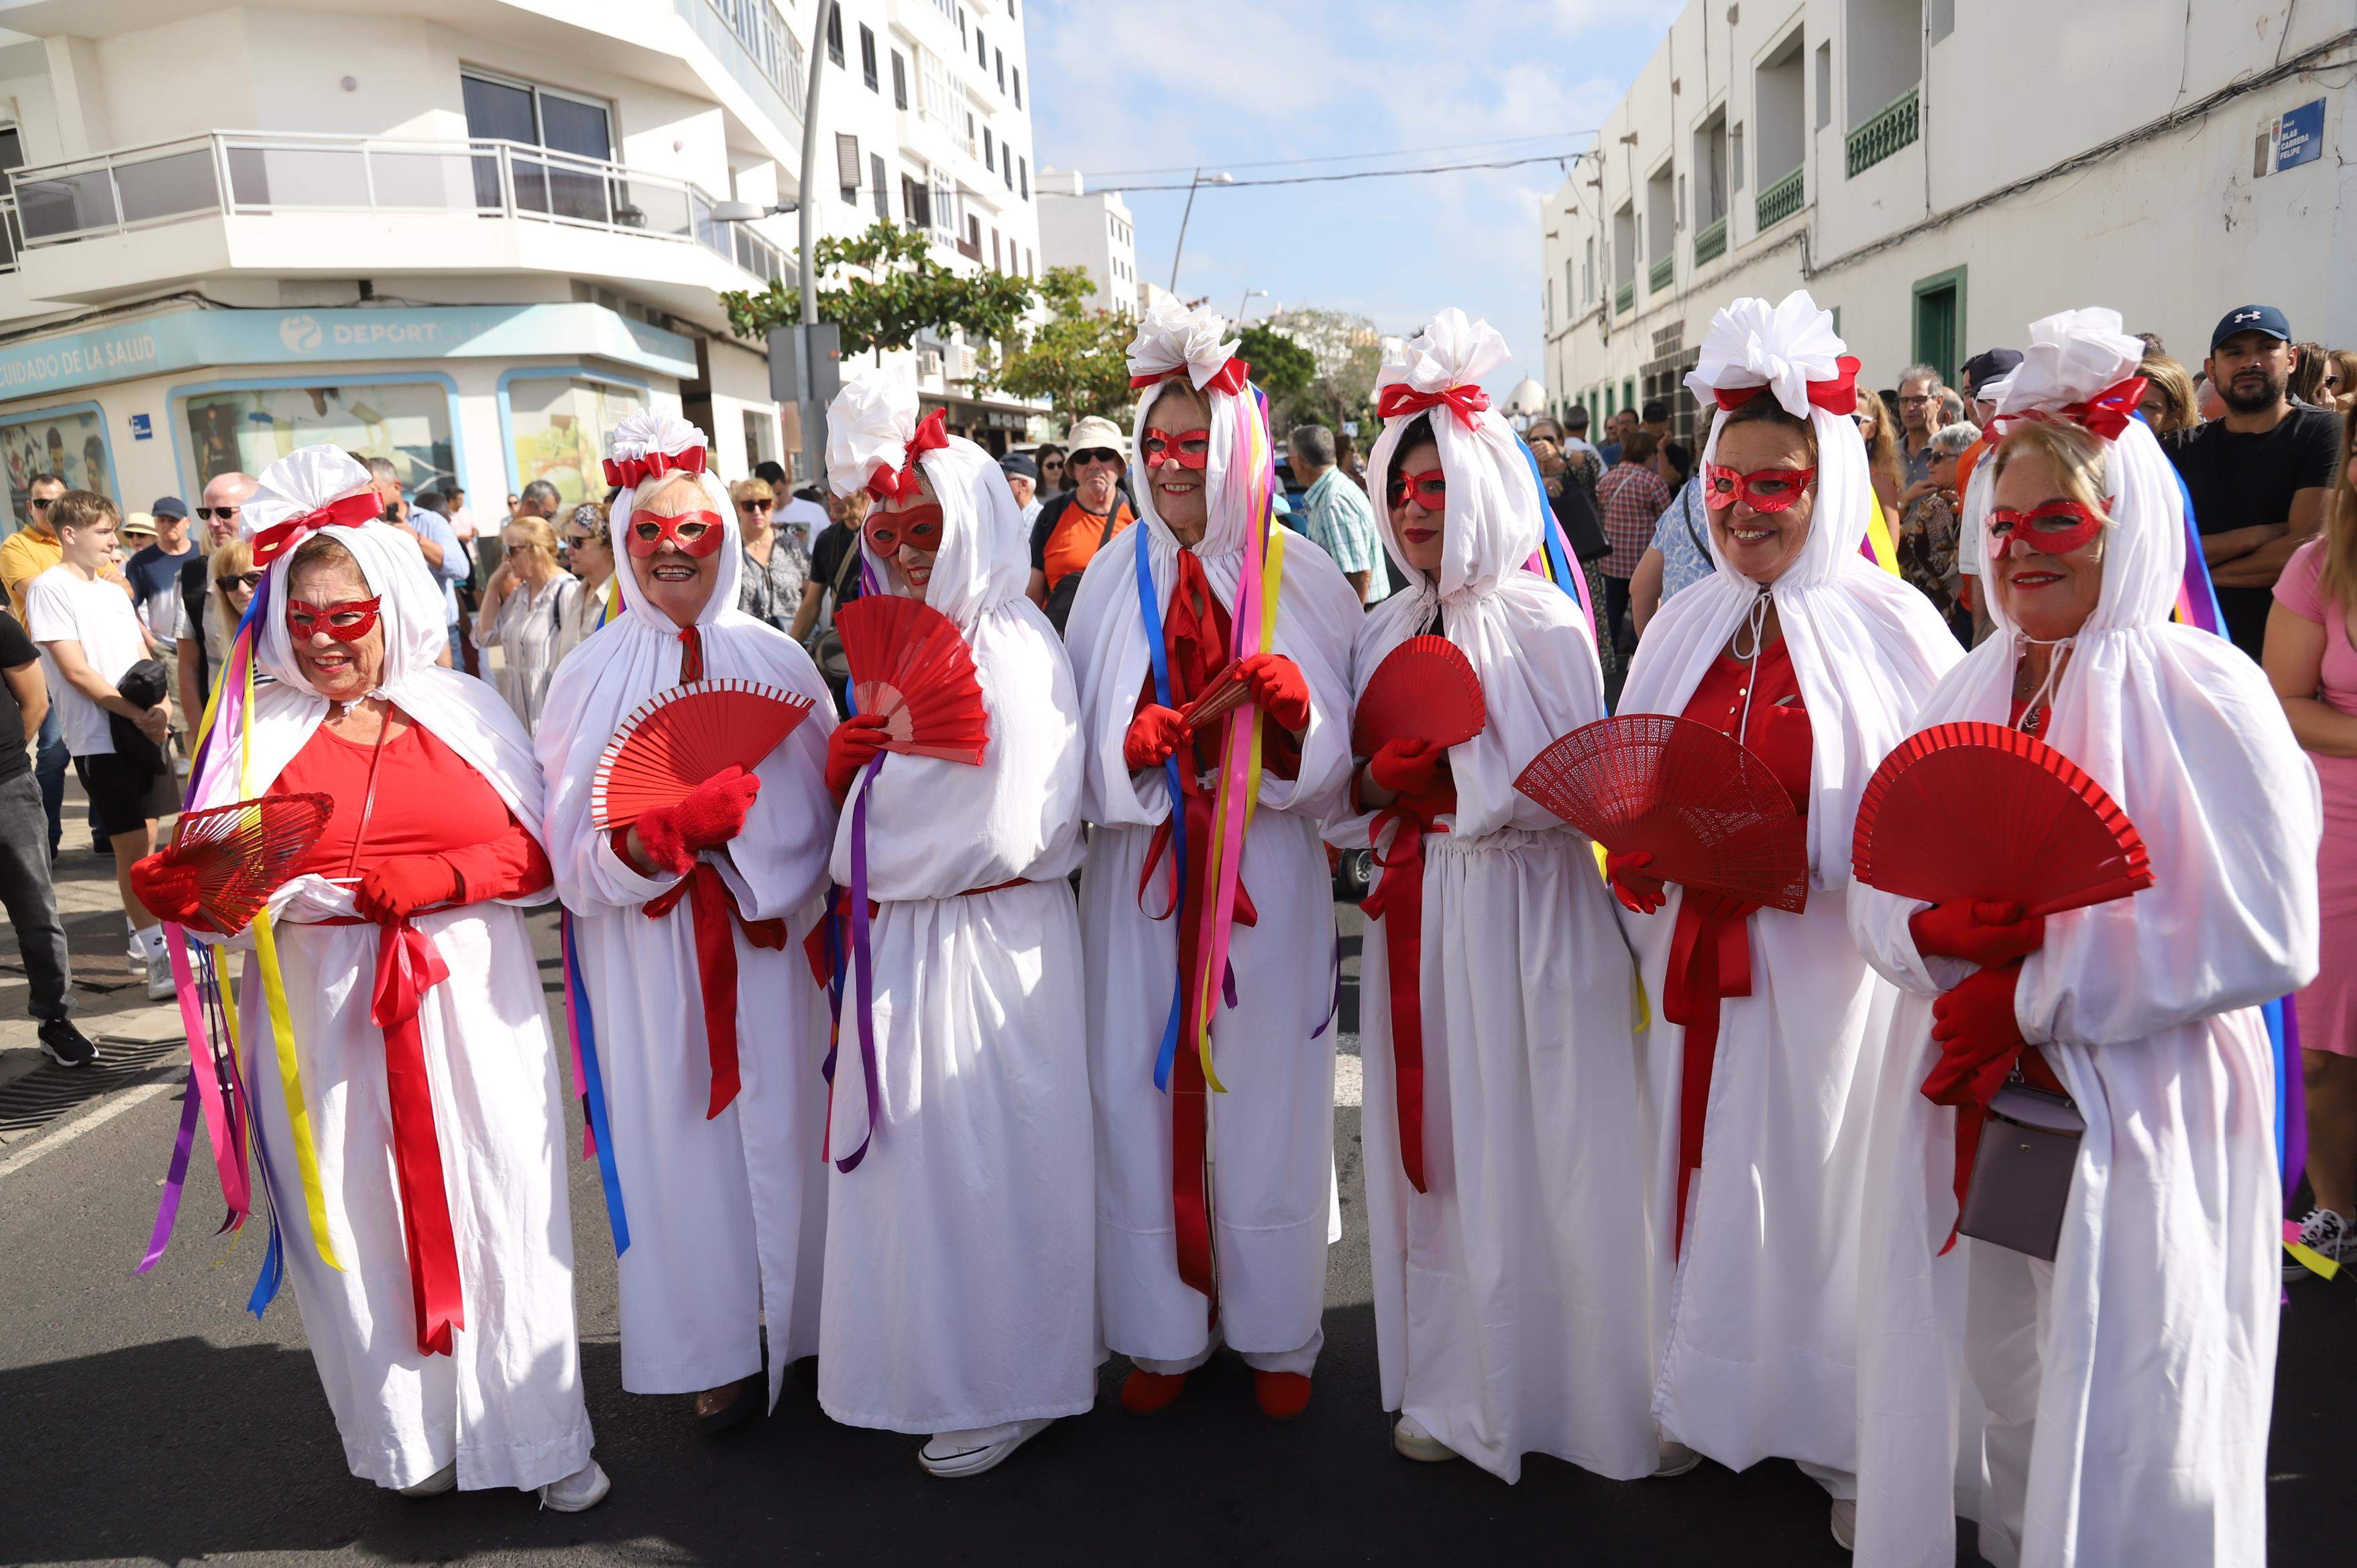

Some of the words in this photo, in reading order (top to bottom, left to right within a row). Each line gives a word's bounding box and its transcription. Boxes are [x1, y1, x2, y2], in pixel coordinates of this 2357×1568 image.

[2281, 133, 2309, 151] CABRERA
[2282, 128, 2298, 141] BLAS
[2280, 145, 2301, 161] FELIPE
[61, 349, 82, 375] DE
[83, 346, 103, 371] LA
[105, 335, 156, 366] SALUD
